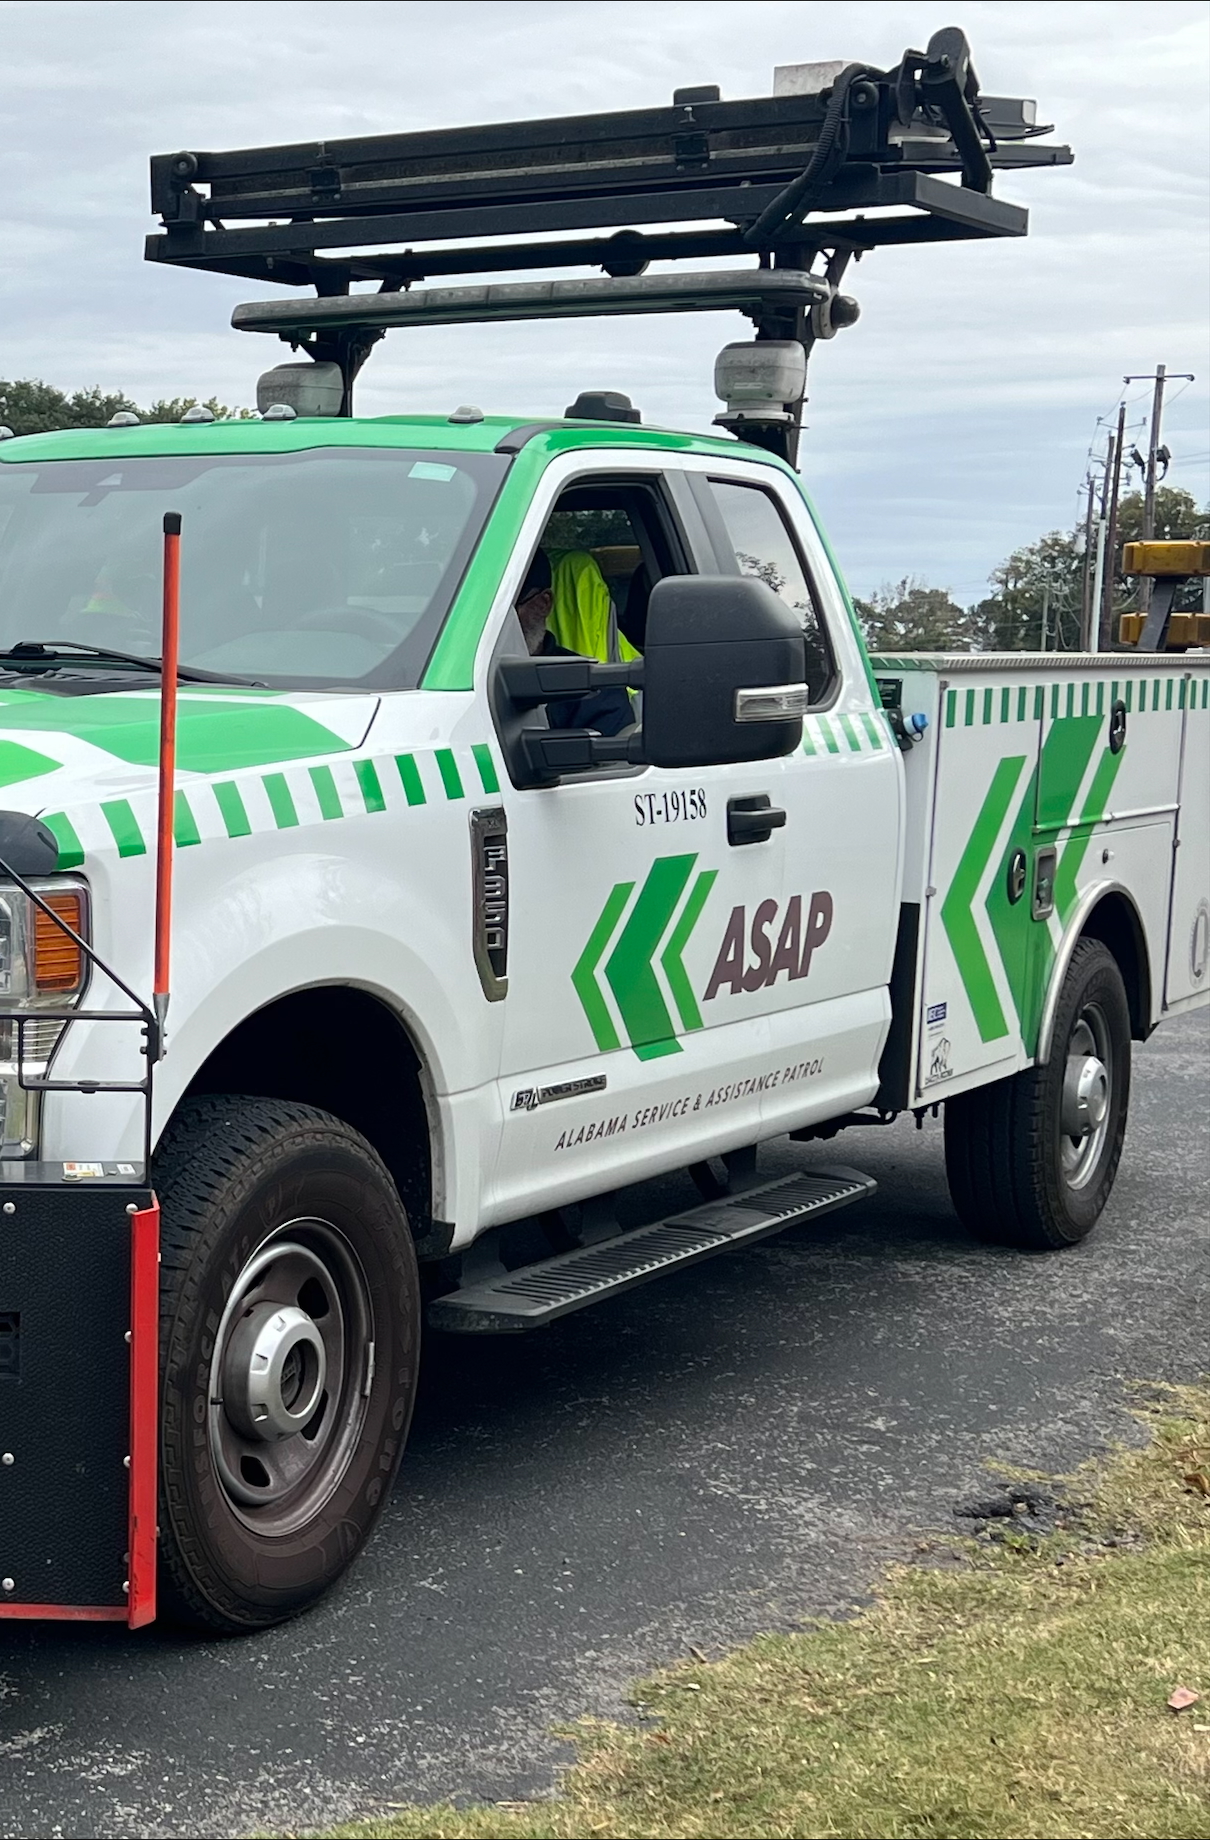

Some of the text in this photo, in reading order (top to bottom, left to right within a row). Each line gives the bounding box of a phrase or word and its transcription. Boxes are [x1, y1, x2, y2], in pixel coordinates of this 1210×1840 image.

[634, 788, 707, 826] ST-19158
[702, 891, 833, 1002] ASAP
[555, 1056, 825, 1151] ALABAMA SERVICE & ASSISTANCE PATROL
